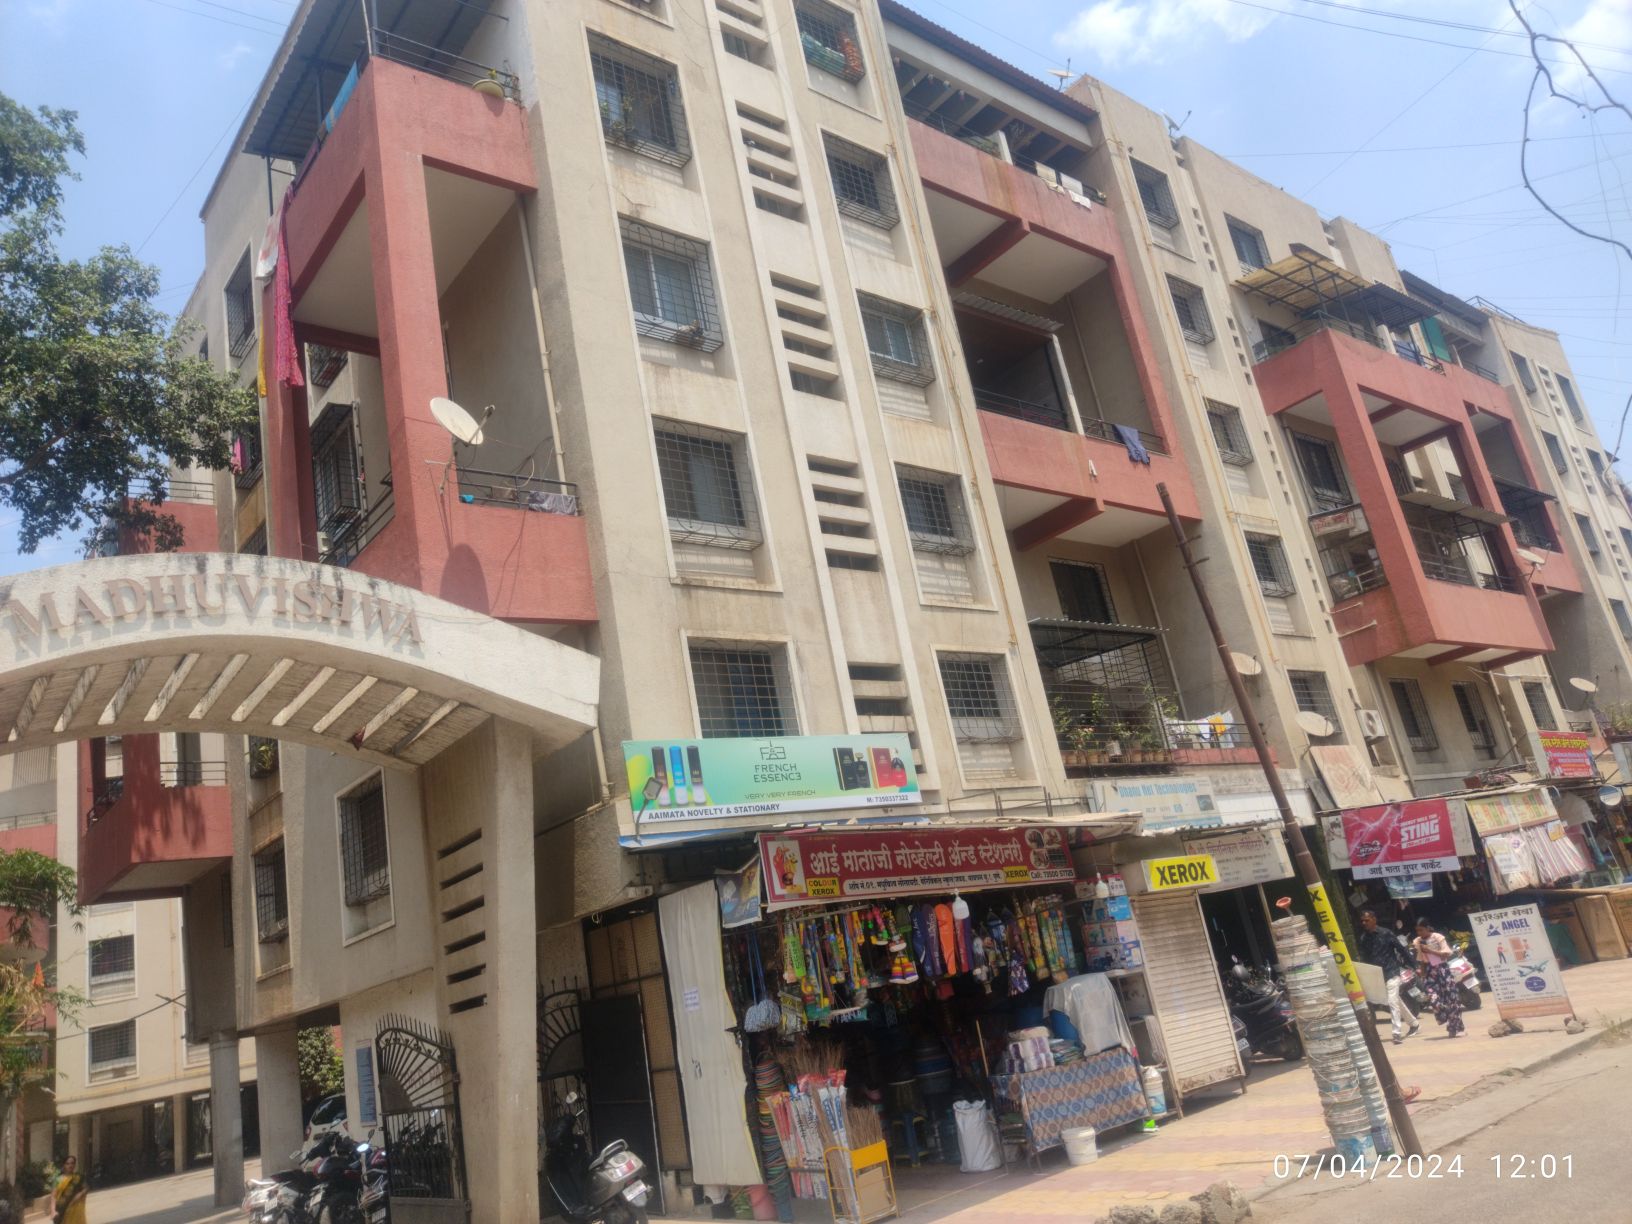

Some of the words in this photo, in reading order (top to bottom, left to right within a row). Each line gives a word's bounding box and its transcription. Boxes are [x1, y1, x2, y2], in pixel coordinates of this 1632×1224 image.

[10, 574, 425, 644] MADHUVISHWA
[754, 763, 798, 773] FRENCH
[787, 789, 816, 797] FRENCH
[648, 810, 685, 820] AAIMATA
[686, 807, 724, 818] NOVELTY
[726, 806, 732, 815] &
[733, 803, 780, 814] STATIONARY
[1401, 819, 1440, 842] STING
[810, 844, 840, 876] आई
[842, 843, 893, 873] माताजी
[978, 838, 1024, 865] स्टेशनरी
[1005, 869, 1028, 879] XEROX
[1156, 861, 1210, 886] XEROX
[1368, 863, 1383, 876] आई
[808, 879, 837, 888] COLOUR
[811, 887, 836, 896] XEROX
[1501, 918, 1530, 931] ANGEL
[1310, 890, 1354, 986] XEROX
